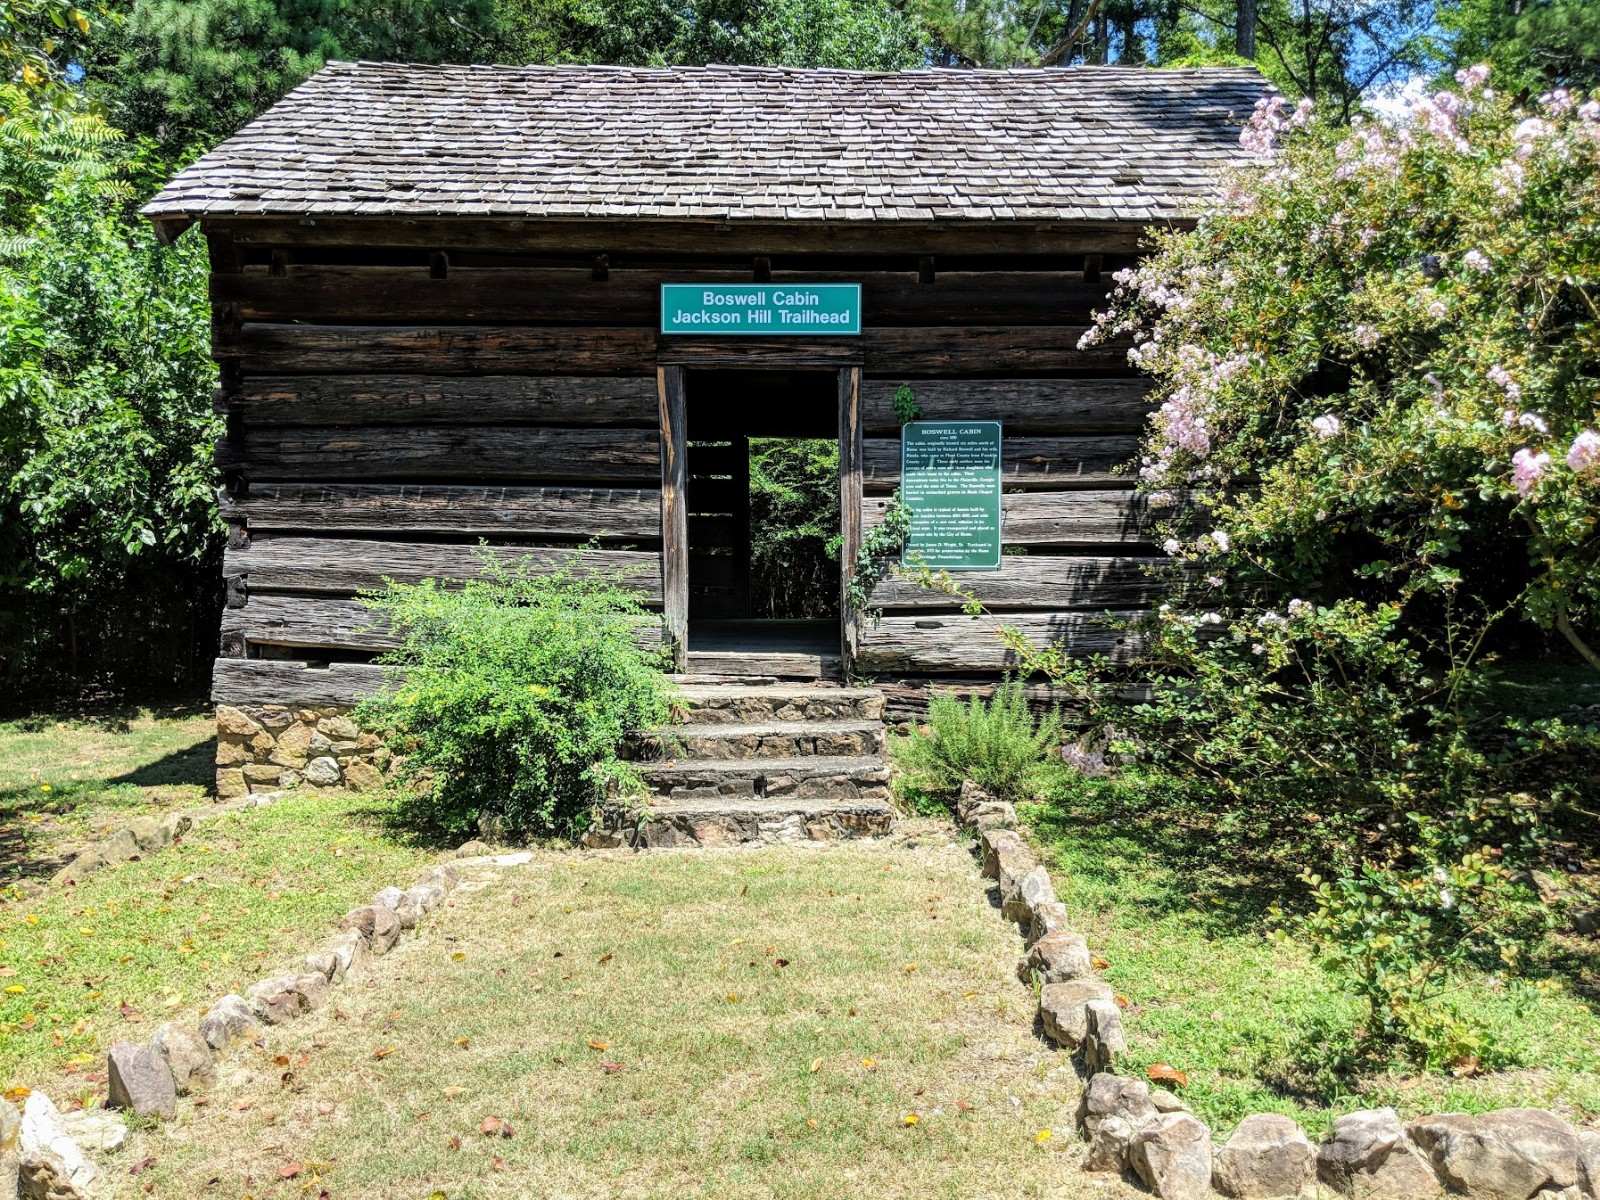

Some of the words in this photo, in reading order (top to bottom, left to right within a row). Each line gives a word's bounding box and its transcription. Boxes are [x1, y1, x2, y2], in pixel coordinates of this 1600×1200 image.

[703, 292, 765, 306] Boswell
[772, 292, 818, 306] Cabin
[673, 310, 740, 324] Jackson
[748, 310, 771, 324] Hill
[778, 310, 850, 324] Trailhead
